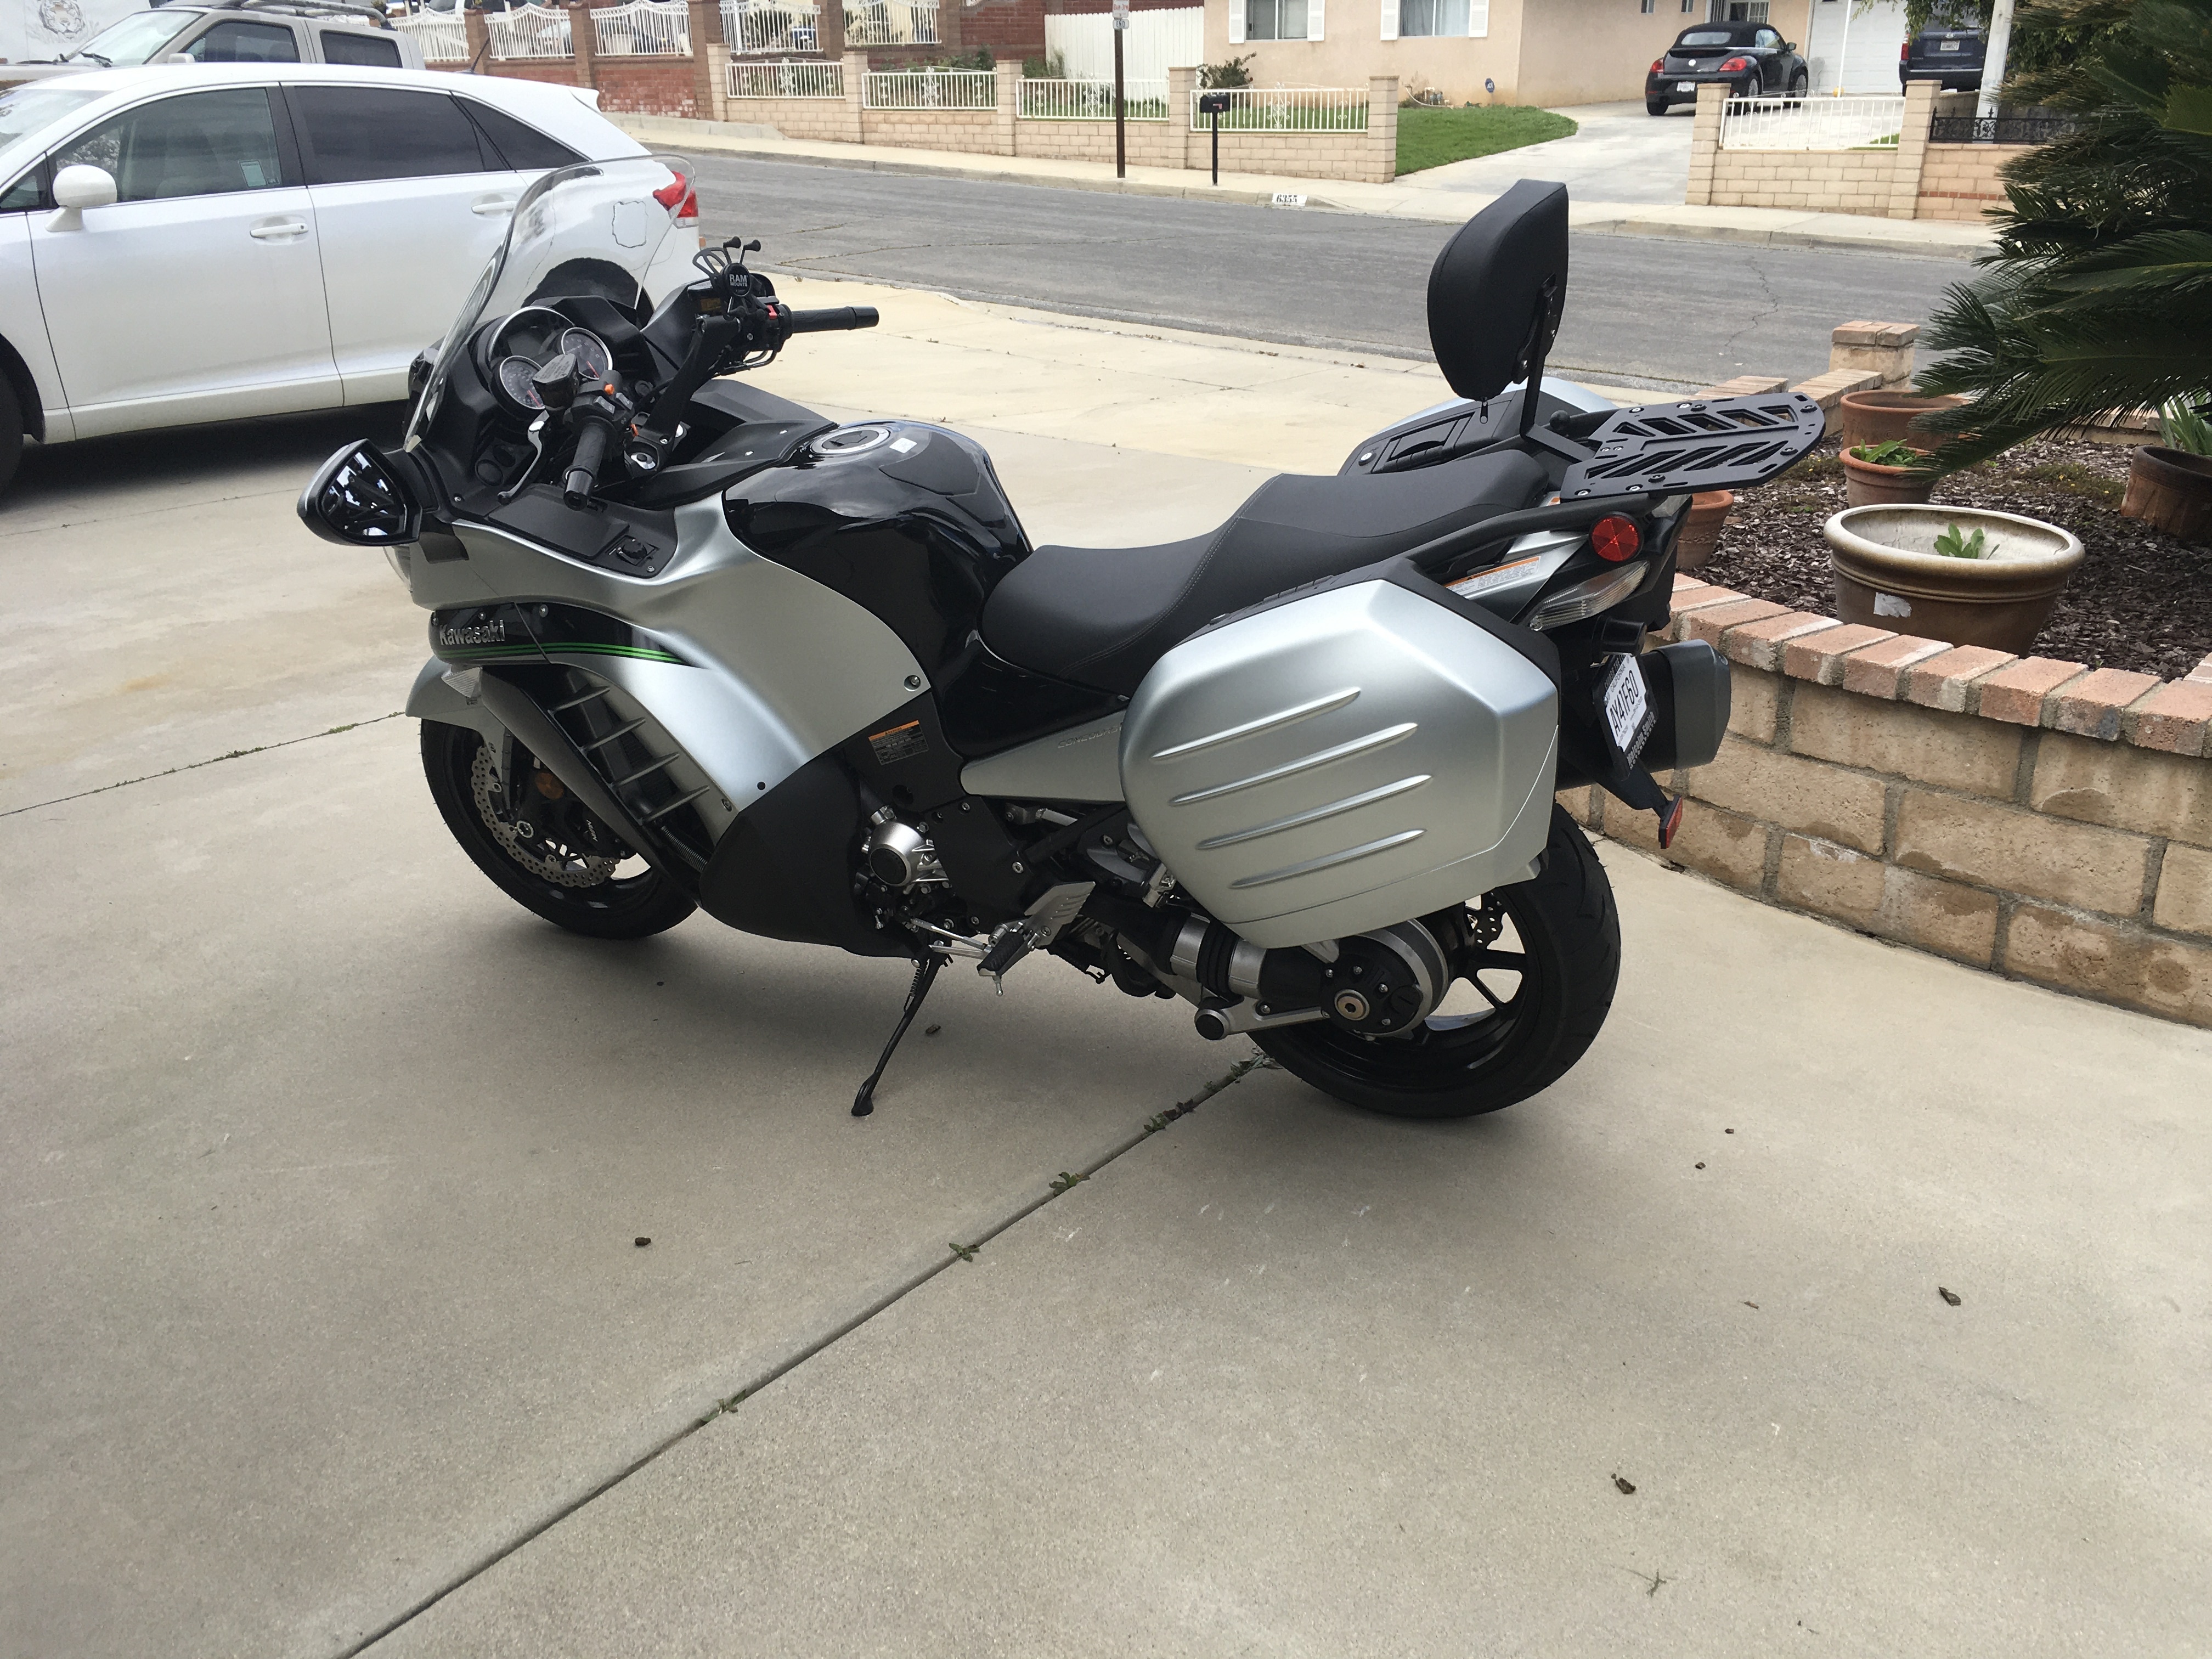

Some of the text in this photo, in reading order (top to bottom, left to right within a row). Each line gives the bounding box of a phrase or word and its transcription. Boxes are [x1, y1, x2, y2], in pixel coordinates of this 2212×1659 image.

[1277, 194, 1297, 202] 6355
[439, 619, 505, 645] Kawasaki
[1610, 670, 1639, 737] AY41F60
